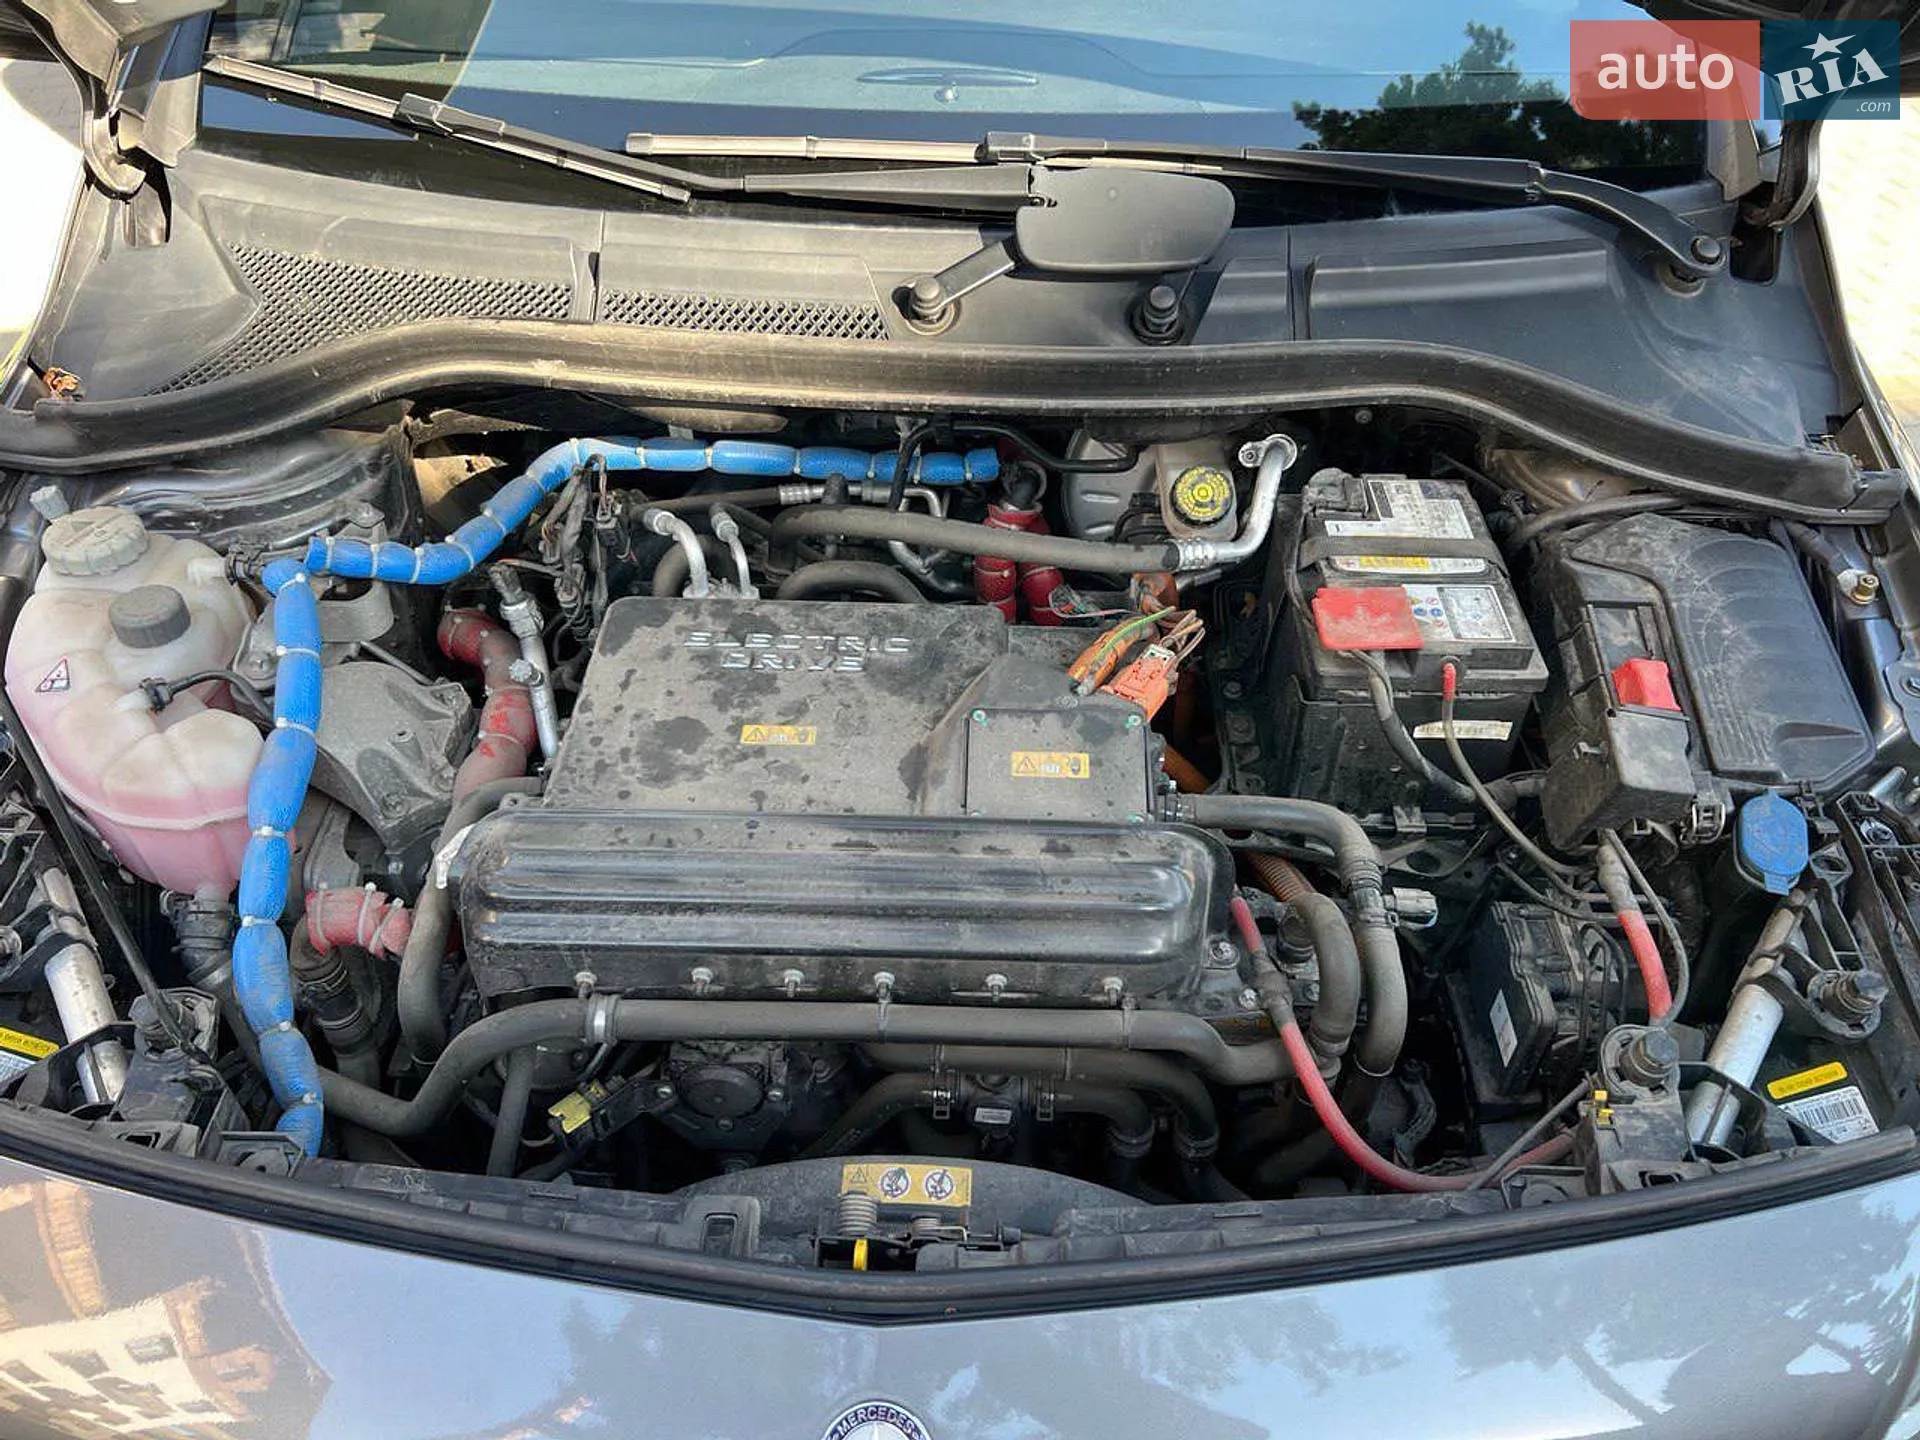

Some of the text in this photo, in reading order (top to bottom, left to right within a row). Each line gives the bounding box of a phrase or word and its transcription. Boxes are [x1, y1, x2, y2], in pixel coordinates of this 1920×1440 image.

[684, 630, 911, 652] ELECTRIC
[720, 651, 865, 672] DRIVE
[837, 1406, 915, 1438] MERCEDES
